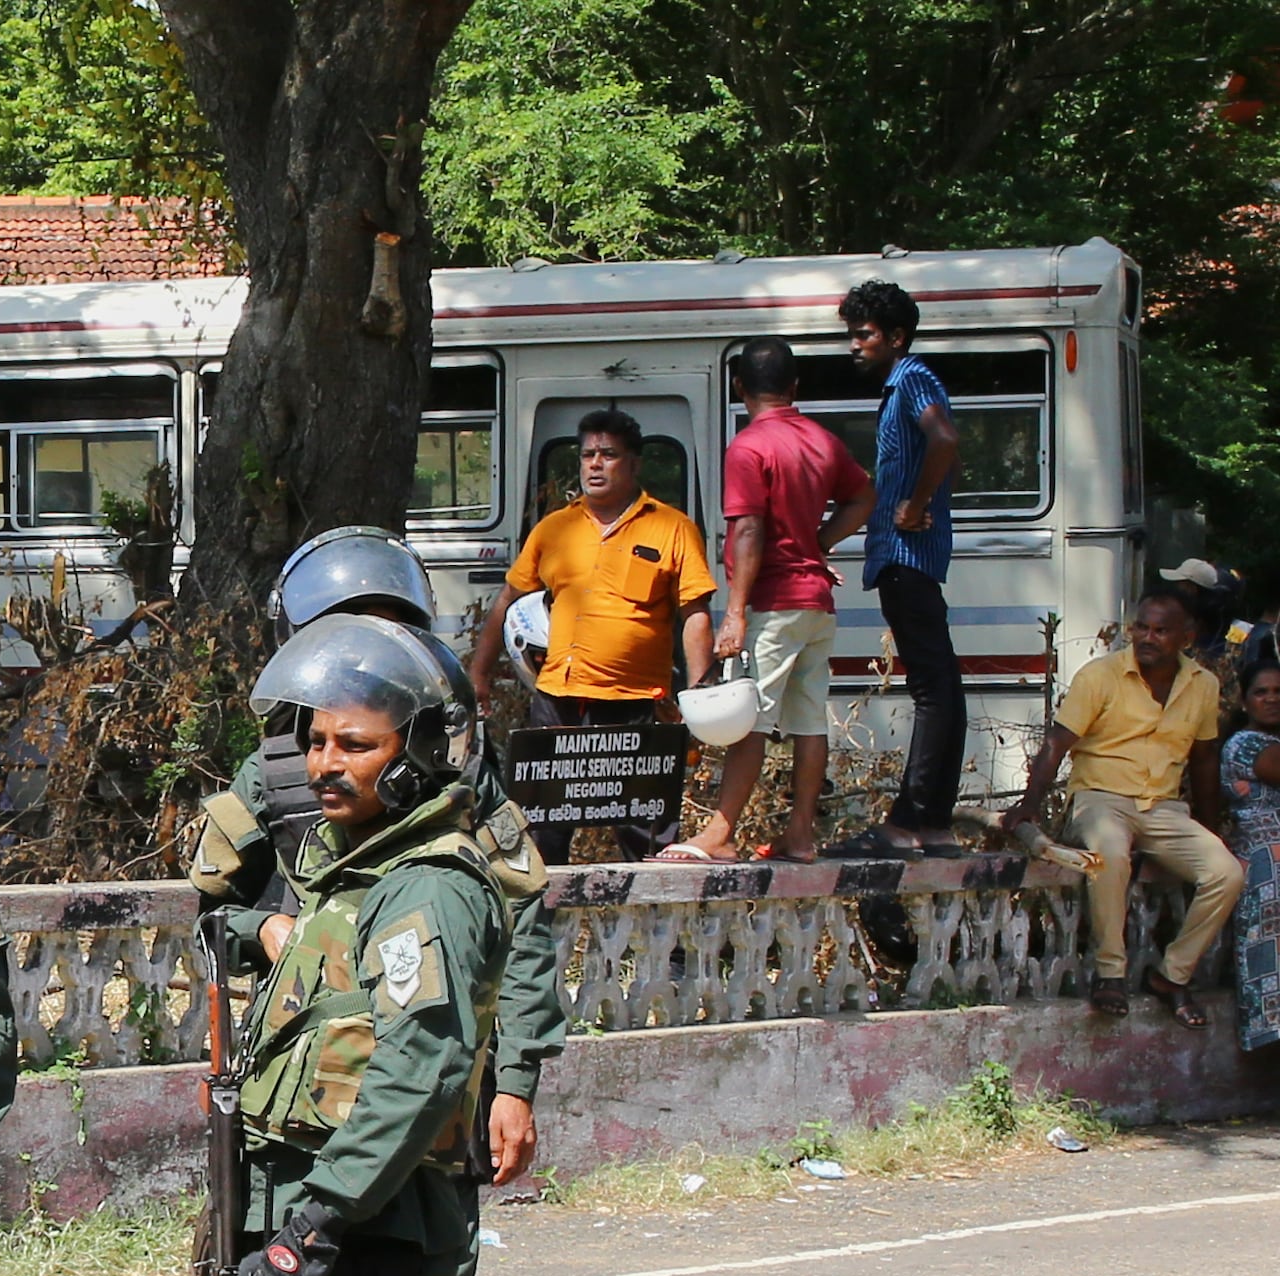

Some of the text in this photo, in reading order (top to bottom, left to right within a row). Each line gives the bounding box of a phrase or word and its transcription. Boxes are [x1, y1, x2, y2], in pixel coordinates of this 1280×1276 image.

[479, 548, 496, 557] IN
[555, 732, 640, 754] MAINTAINED
[515, 755, 676, 781] BY THE PUBLIC SERVICES CLUB OF
[565, 781, 622, 798] NEGOMBO
